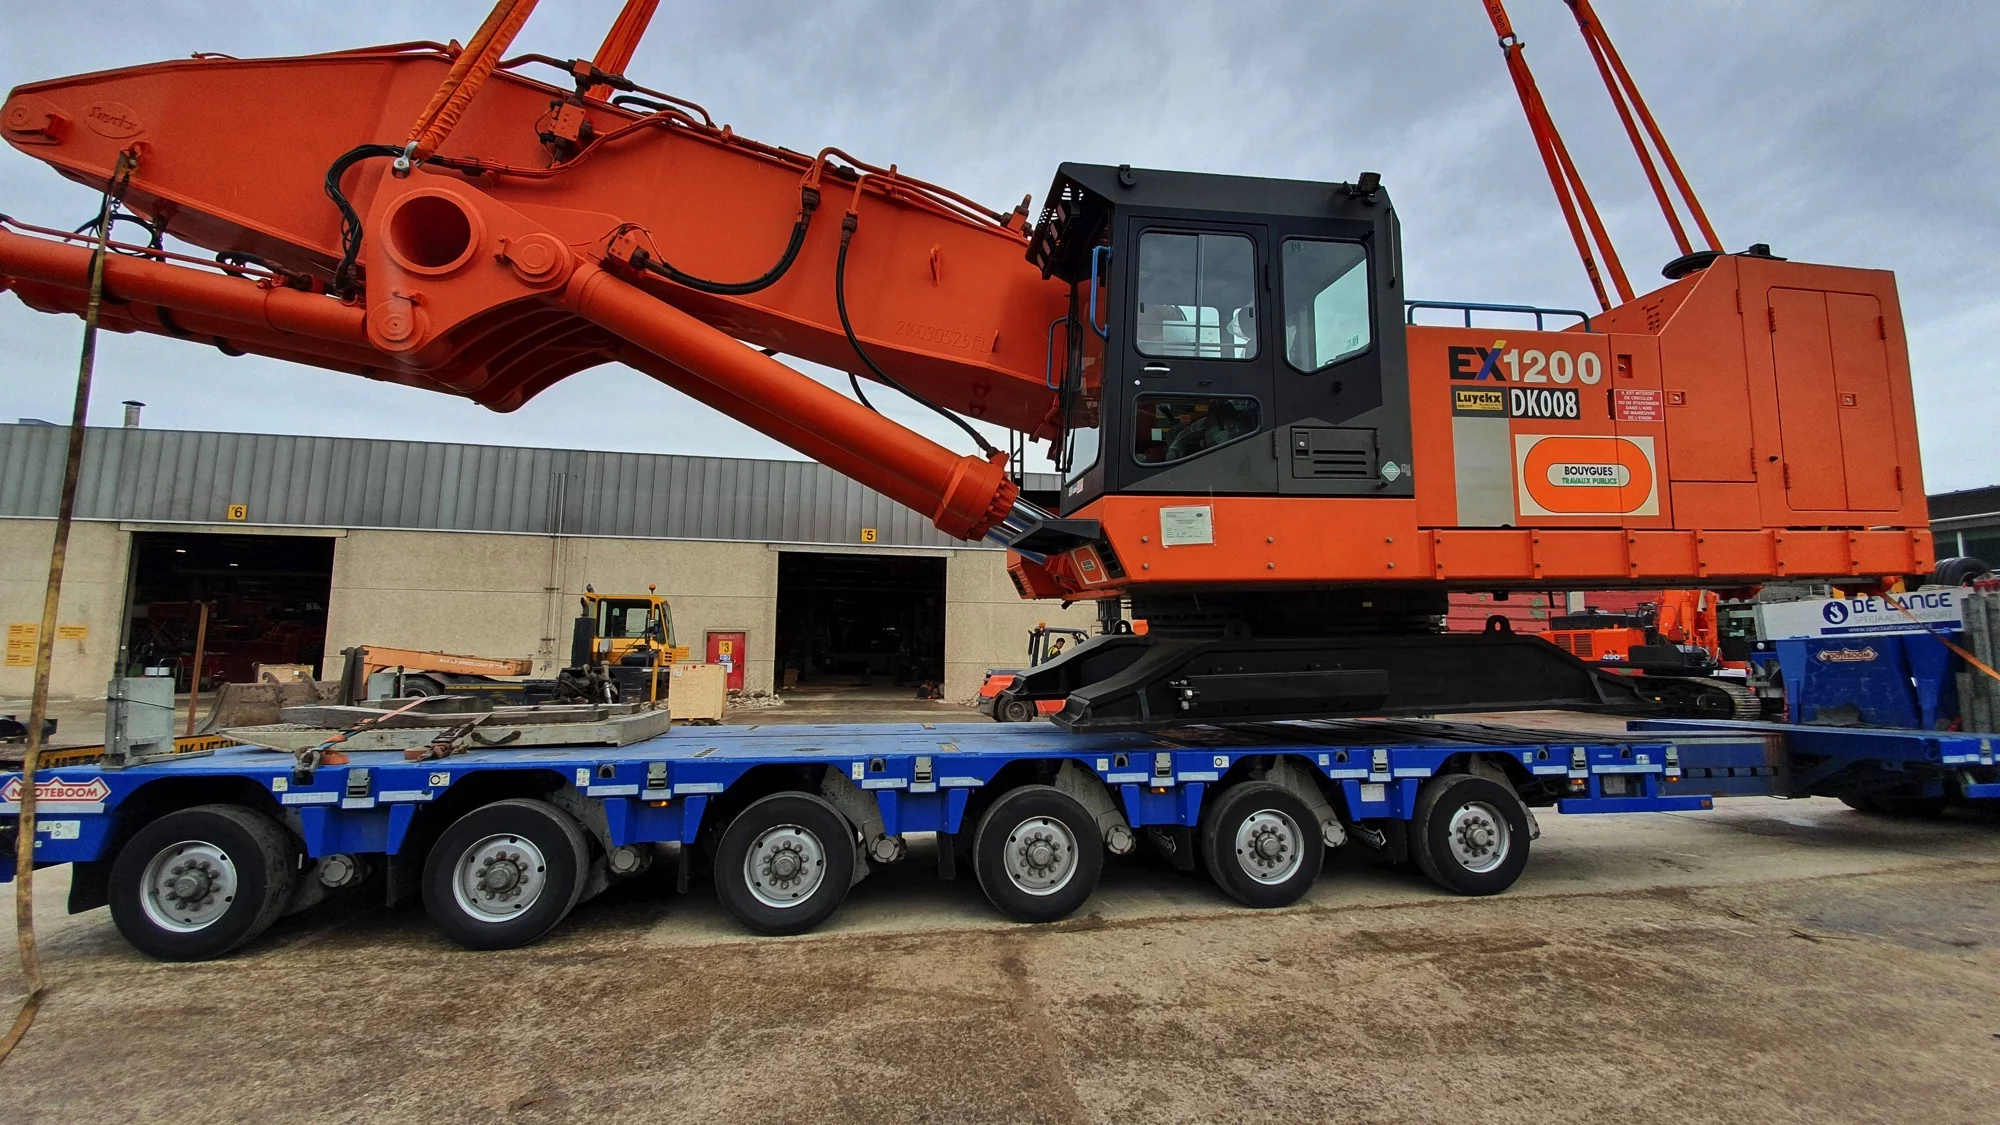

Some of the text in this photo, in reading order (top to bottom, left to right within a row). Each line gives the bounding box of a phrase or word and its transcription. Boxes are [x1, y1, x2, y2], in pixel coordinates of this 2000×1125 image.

[1448, 340, 1602, 386] EX1200
[1456, 392, 1502, 405] Luyckx
[1510, 388, 1578, 418] DK008
[1564, 466, 1614, 476] BOUYGUES
[1561, 477, 1592, 485] TRAVAUX
[1852, 599, 1878, 614] DE
[1897, 610, 1953, 622] TRNSPORT
[11, 786, 99, 798] NOTEBOOM
